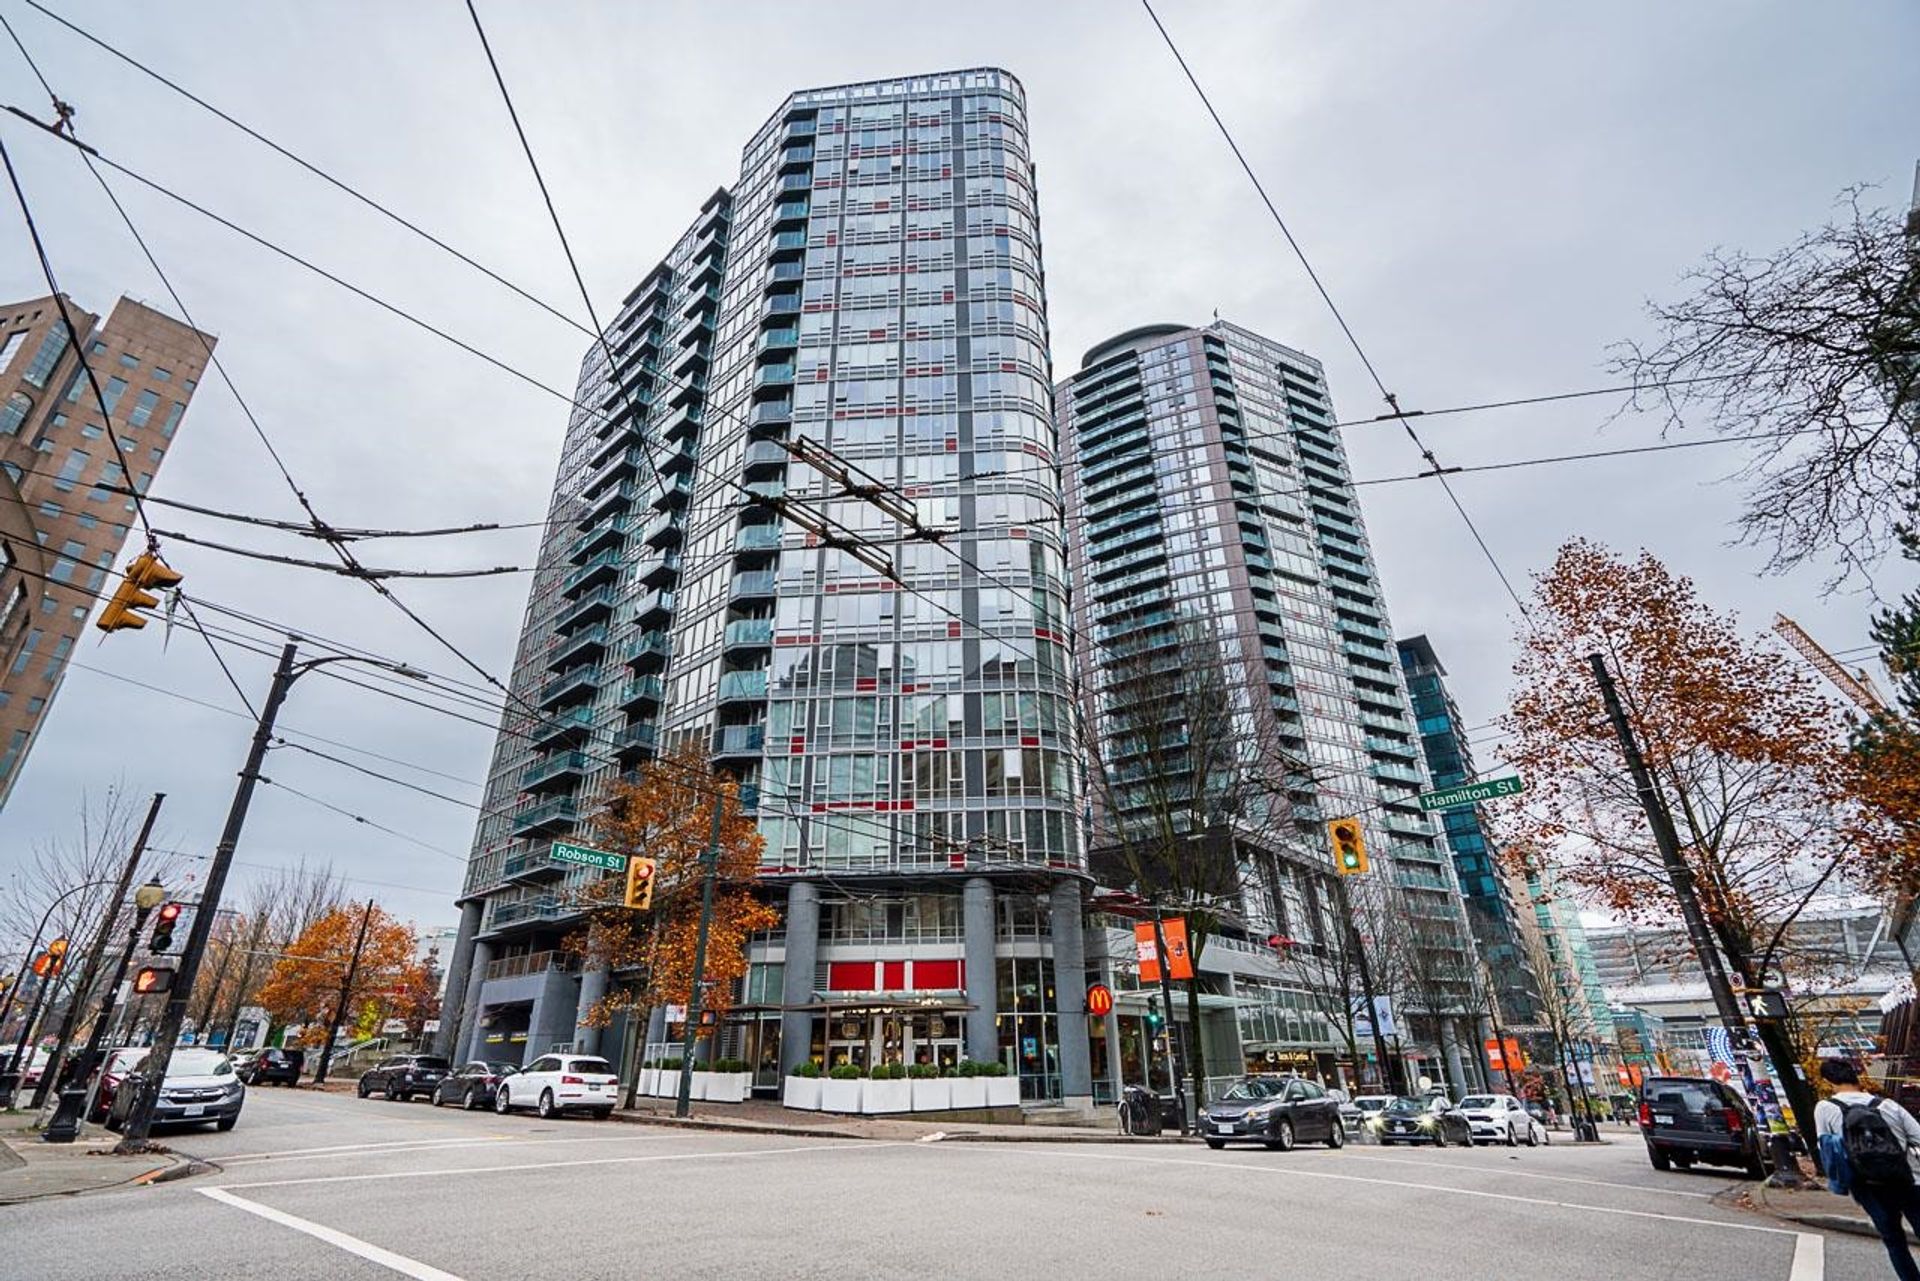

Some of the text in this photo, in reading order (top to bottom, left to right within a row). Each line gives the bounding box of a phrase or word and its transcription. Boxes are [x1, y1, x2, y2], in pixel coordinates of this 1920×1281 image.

[1424, 780, 1515, 808] Hamilton St
[557, 846, 620, 868] Robson St
